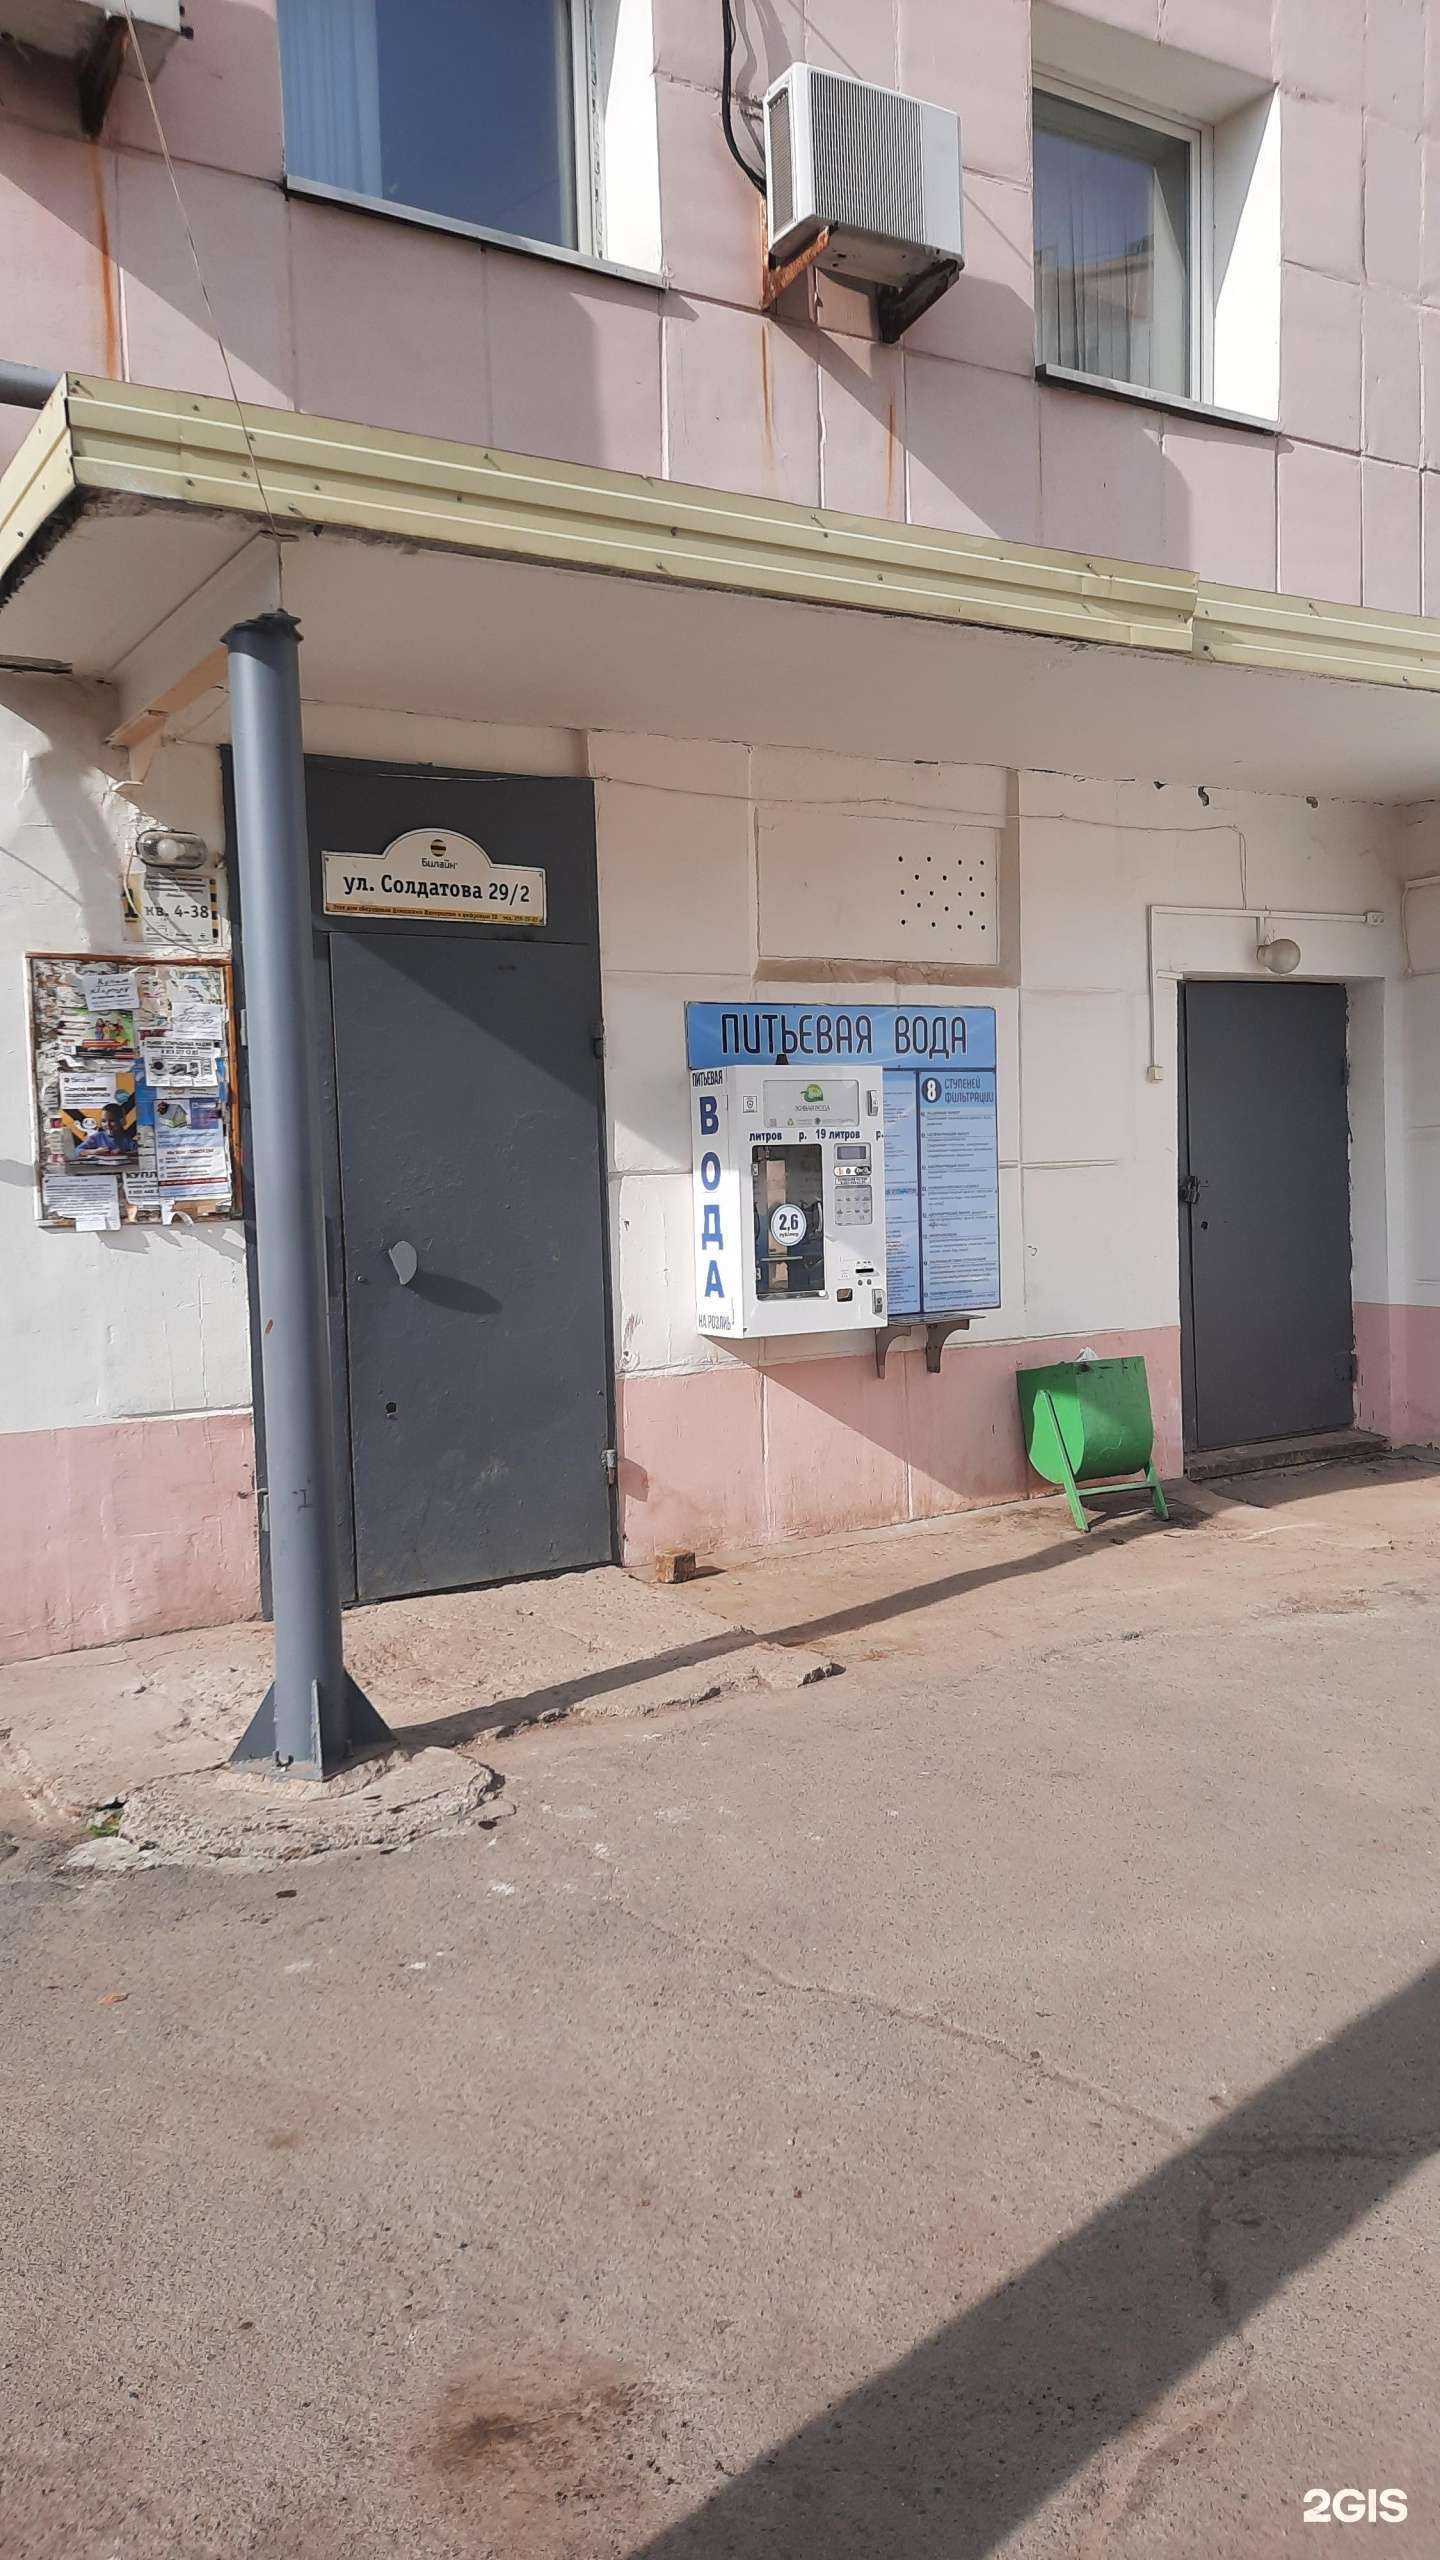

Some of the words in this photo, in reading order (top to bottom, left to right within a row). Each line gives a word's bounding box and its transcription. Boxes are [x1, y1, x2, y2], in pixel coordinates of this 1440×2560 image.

[421, 857, 457, 869] Билайн
[343, 876, 375, 895] ул.
[381, 874, 482, 899] Солдатова
[488, 883, 530, 905] 29/2
[174, 905, 209, 918] 4-38
[721, 1014, 873, 1055] ПИТЬЕВАЯ
[894, 1015, 968, 1059] ВОДА
[692, 1071, 724, 1088] ПИТЬЕВАЯ
[945, 1076, 981, 1090] СТУПЕНЕЙ
[926, 1079, 937, 1101] 8
[945, 1092, 994, 1104] ФИЛЬТРАЦИИ
[749, 1132, 782, 1143] литров
[798, 1132, 807, 1142] р.
[816, 1128, 826, 1140] 19
[829, 1131, 861, 1142] литров
[779, 1213, 799, 1232] 2,6
[698, 1314, 707, 1328] НА
